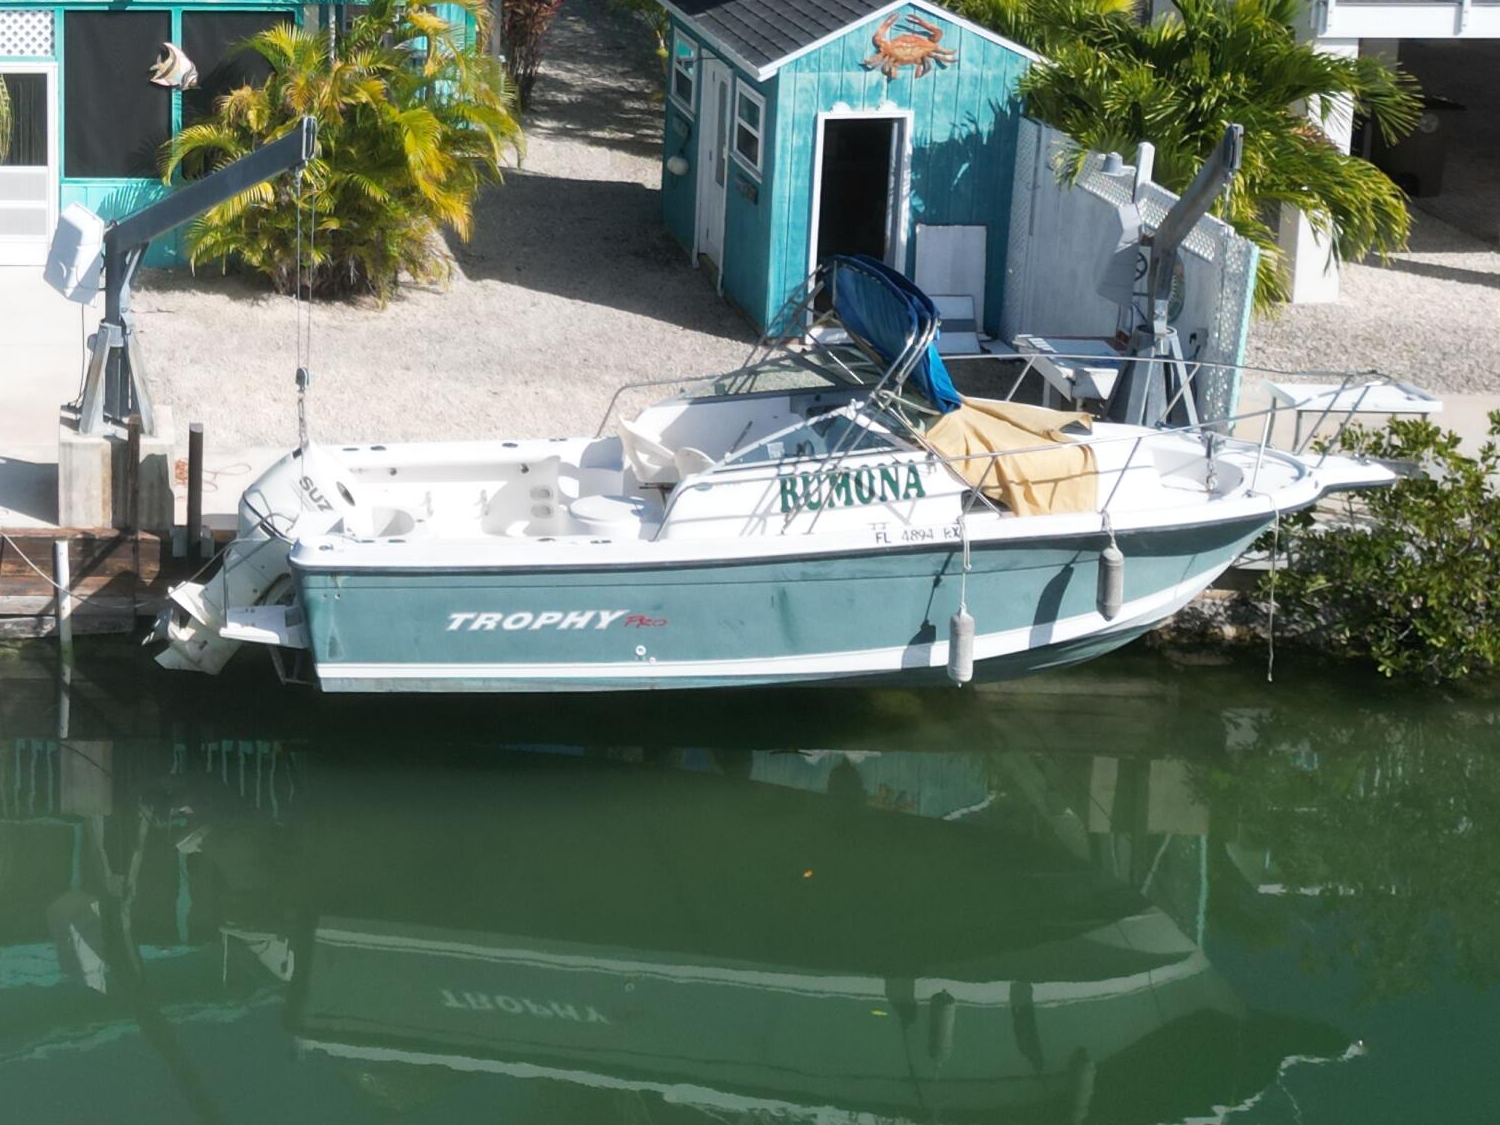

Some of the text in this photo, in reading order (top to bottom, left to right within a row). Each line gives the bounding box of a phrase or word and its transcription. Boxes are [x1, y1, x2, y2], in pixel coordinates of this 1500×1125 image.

[781, 460, 926, 513] RUMONA
[875, 531, 891, 544] FL
[446, 609, 630, 632] TROPHY
